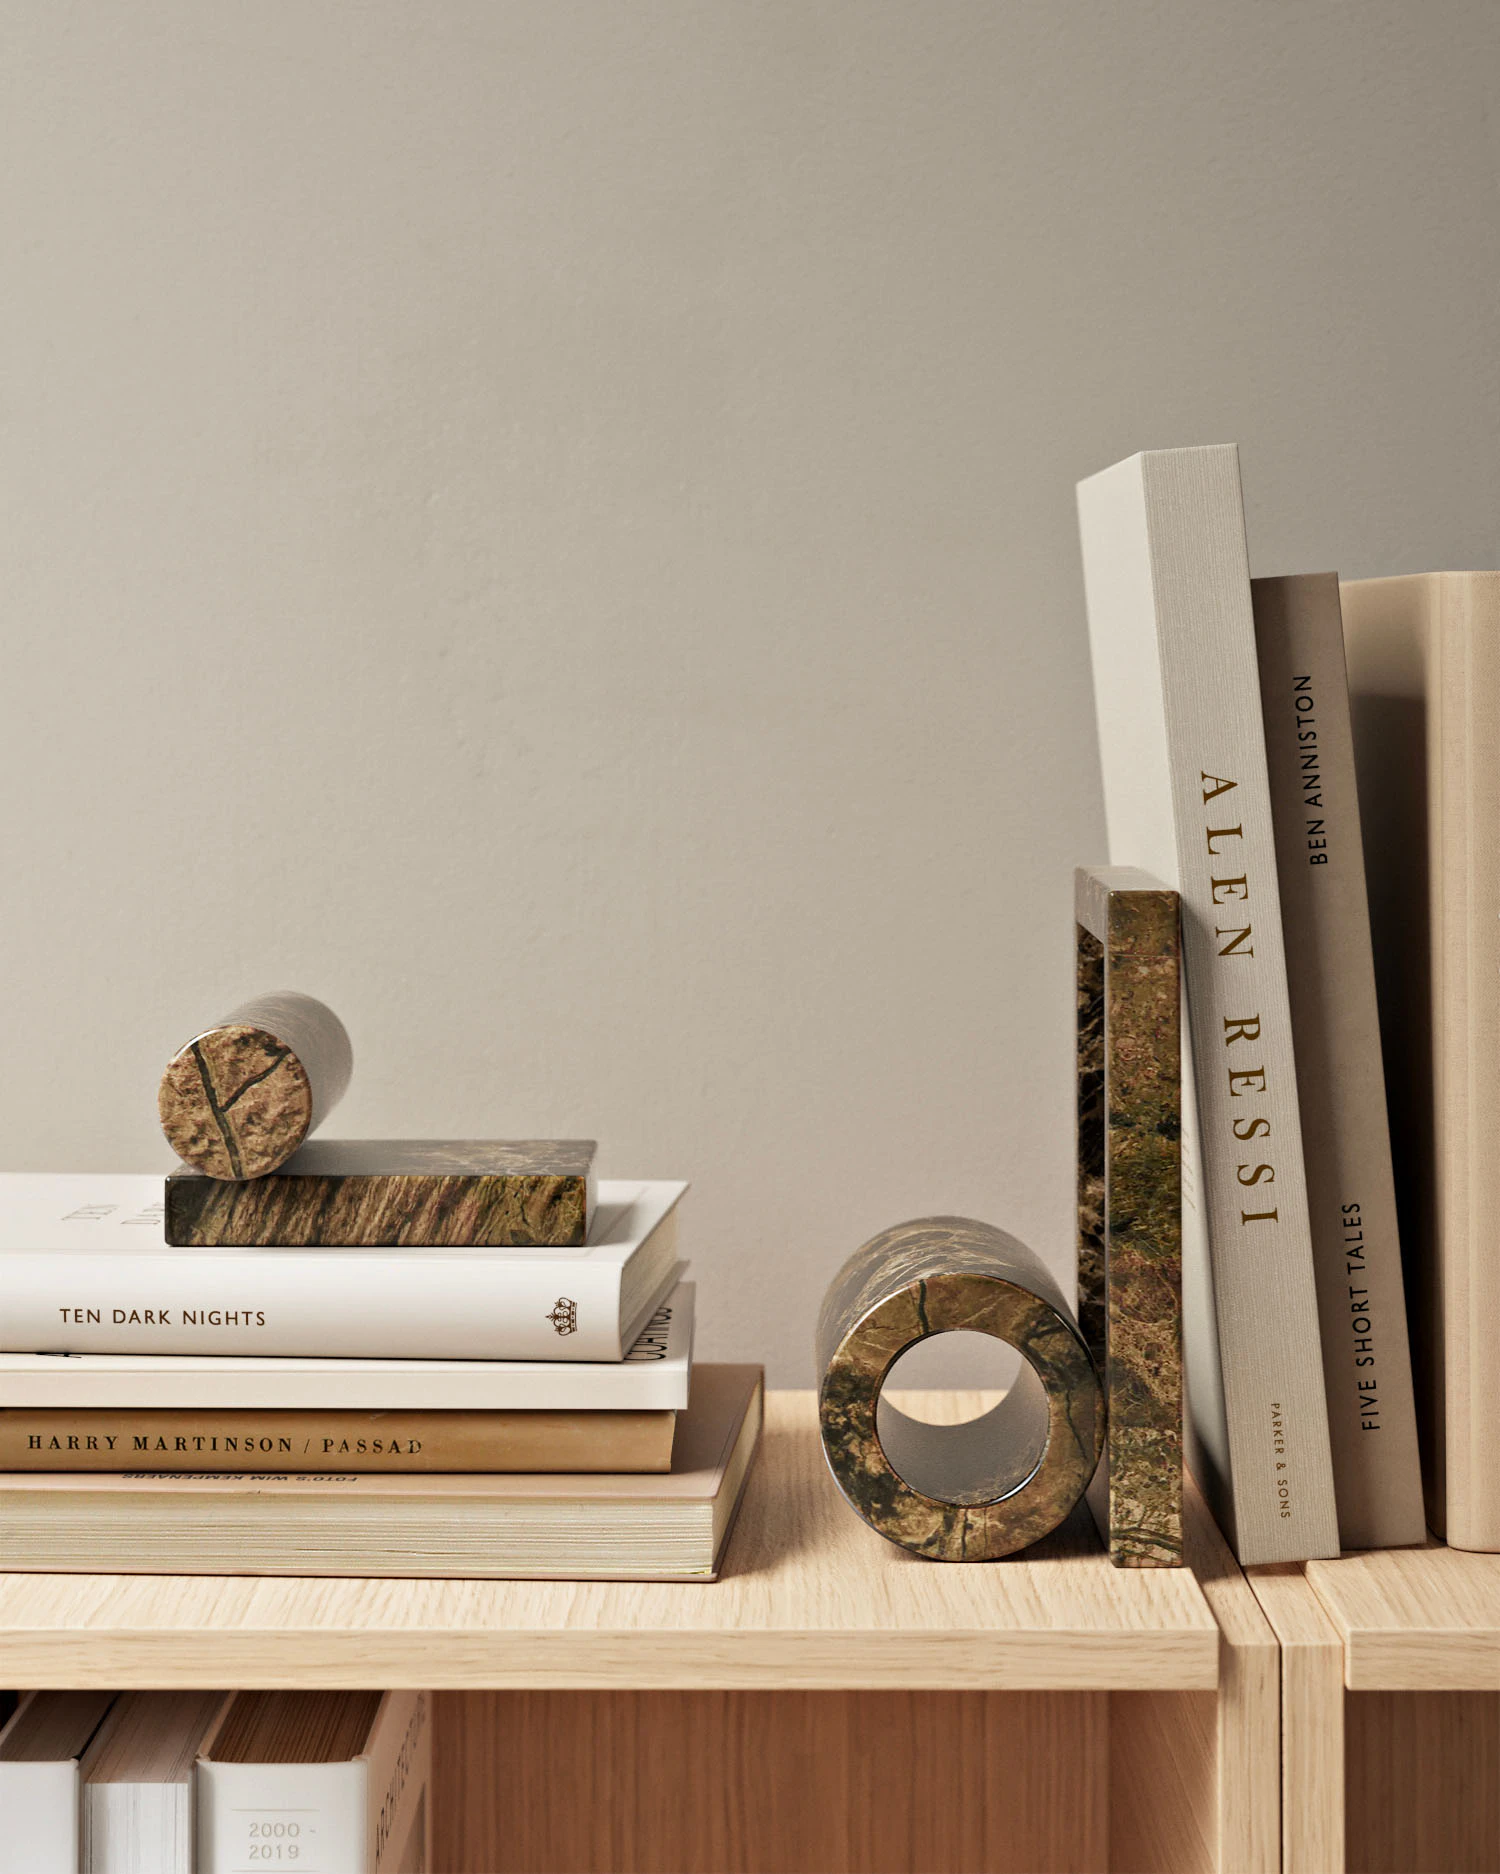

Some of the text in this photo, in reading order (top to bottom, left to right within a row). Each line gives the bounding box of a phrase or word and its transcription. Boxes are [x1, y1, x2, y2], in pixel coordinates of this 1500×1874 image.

[1293, 675, 1329, 865] BEN ANNISTON
[1200, 770, 1280, 1227] ALEN RESSI
[59, 1308, 266, 1327] TEN DARK NIGHTS
[1341, 1203, 1381, 1431] FIVE SHORT TALES
[28, 1434, 117, 1451] HARRY
[133, 1436, 291, 1454] MARTINSON
[322, 1437, 423, 1455] PASSAD
[1270, 1402, 1291, 1519] PARKER & SONS
[249, 1474, 289, 1482] WIM
[248, 1822, 301, 1838] 2000
[248, 1843, 300, 1860] 2019
